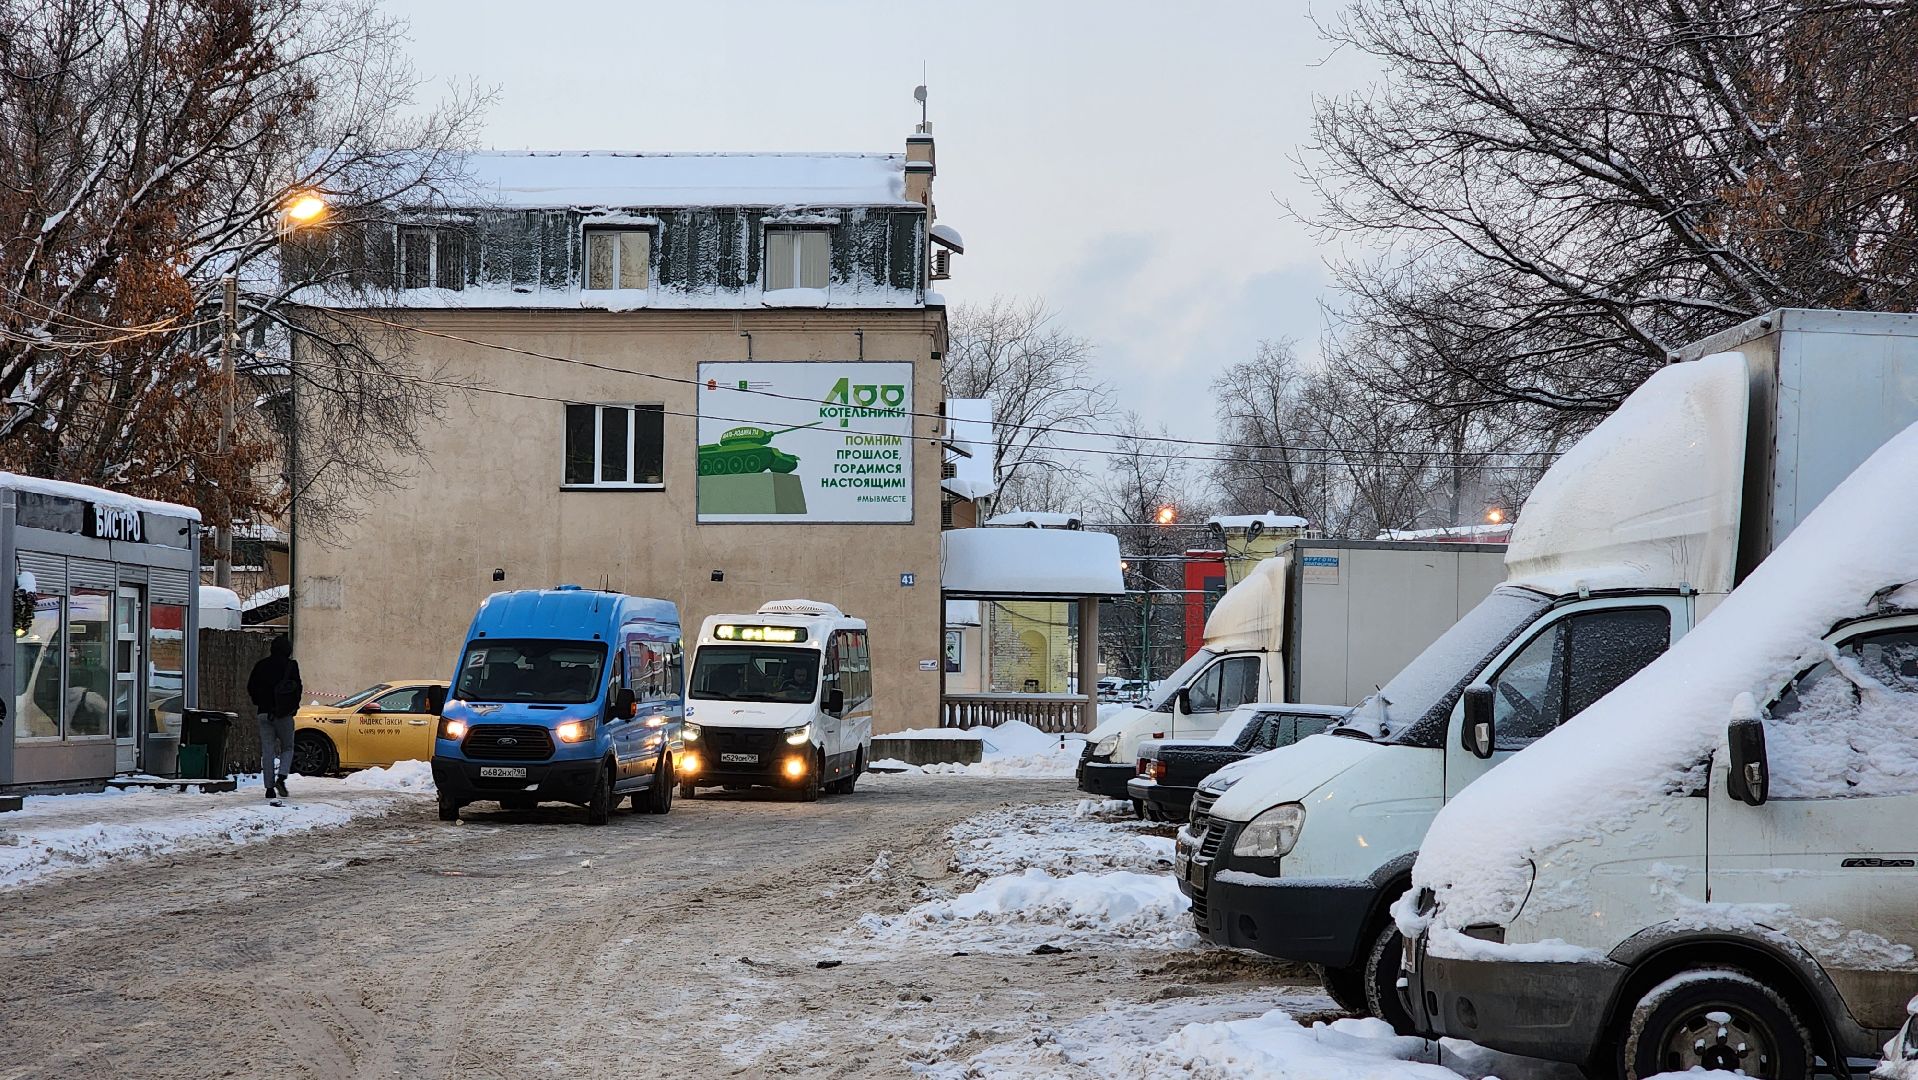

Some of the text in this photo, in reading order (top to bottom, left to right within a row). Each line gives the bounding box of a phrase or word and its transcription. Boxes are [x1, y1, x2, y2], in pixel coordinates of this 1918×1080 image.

[821, 378, 904, 427] 400
[819, 407, 905, 418] КОТЕЛЬНИКИ
[845, 436, 902, 446] ПОМНИМ
[836, 450, 901, 460] ПРОШЛОЕ,
[834, 464, 902, 474] ГОРДИМСЯ
[96, 507, 140, 541] БИСТРО
[901, 575, 914, 585] 41
[469, 653, 485, 667] 2
[360, 716, 402, 725] Яндекс Такси
